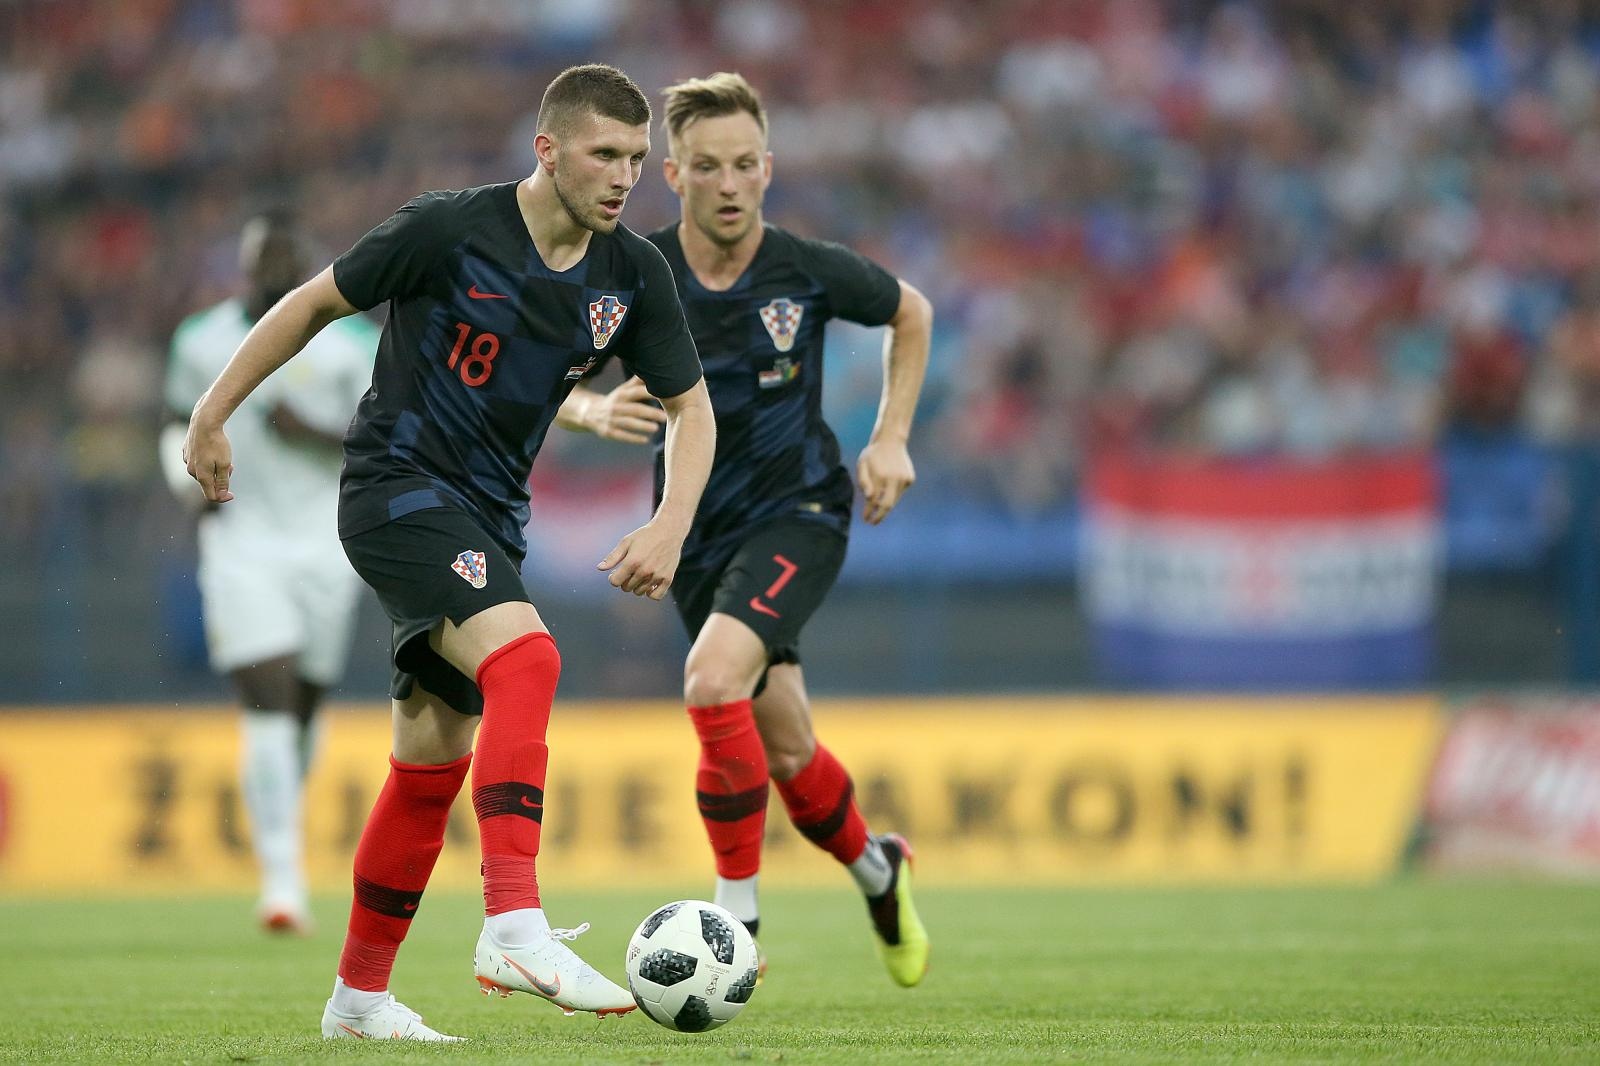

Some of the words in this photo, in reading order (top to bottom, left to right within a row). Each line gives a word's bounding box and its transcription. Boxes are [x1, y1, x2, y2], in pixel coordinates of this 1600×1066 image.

[447, 321, 500, 388] 18
[765, 553, 799, 599] 7
[764, 752, 1312, 848] AKON!
